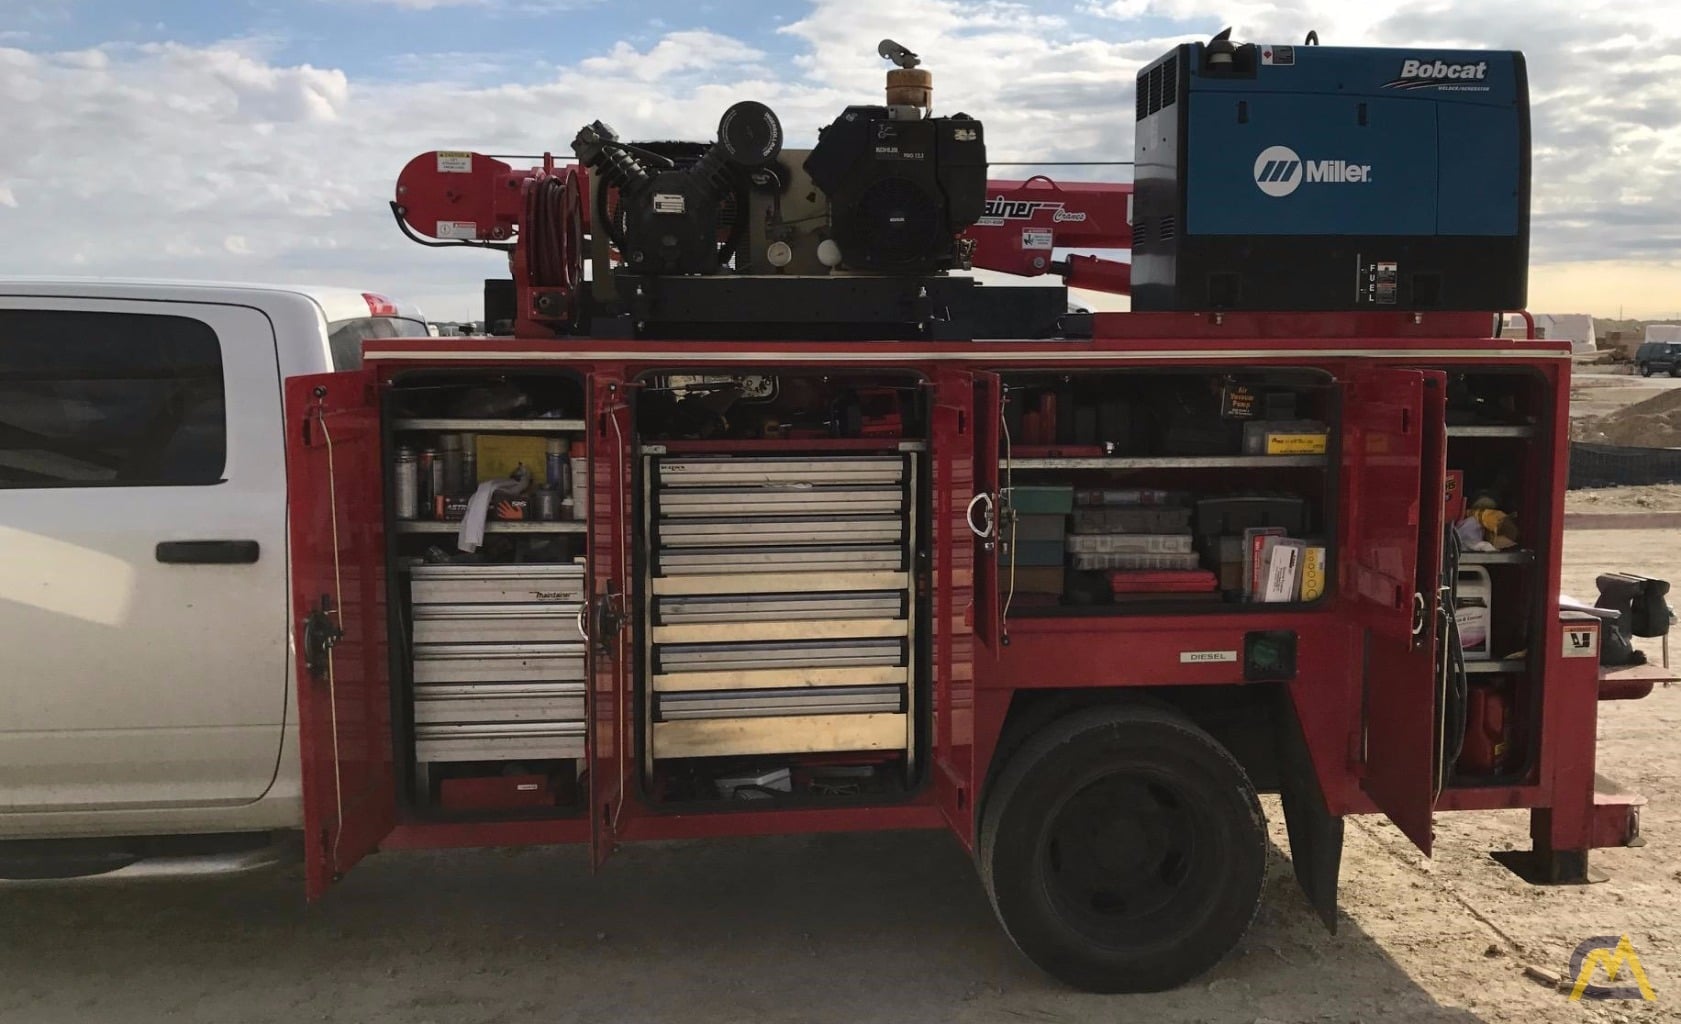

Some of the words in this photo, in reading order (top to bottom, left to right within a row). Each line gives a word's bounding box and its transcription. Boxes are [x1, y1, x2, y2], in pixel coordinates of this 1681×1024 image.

[1400, 59, 1487, 80] Bobcat
[1306, 160, 1371, 183] Miller
[1190, 653, 1227, 661] DIESEL
